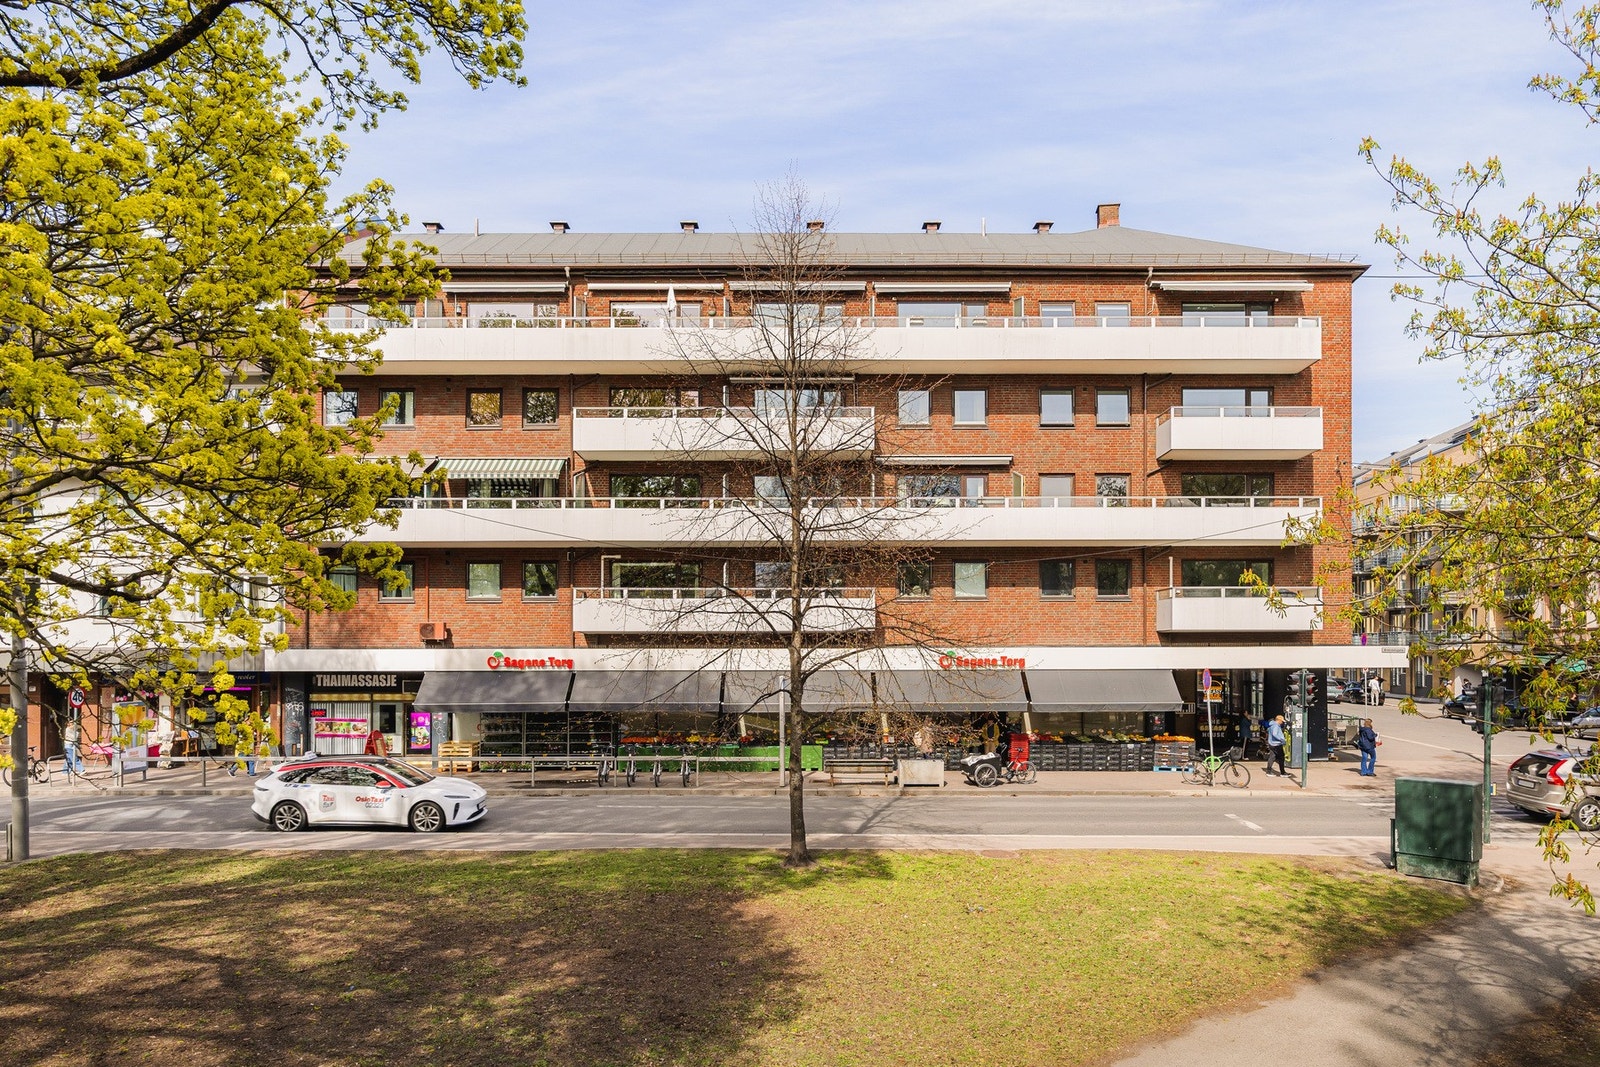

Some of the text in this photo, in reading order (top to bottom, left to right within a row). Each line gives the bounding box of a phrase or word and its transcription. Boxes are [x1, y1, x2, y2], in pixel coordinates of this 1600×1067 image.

[548, 657, 574, 670] Torg
[1000, 656, 1026, 668] Torg
[316, 674, 397, 687] THAIMASSASJE
